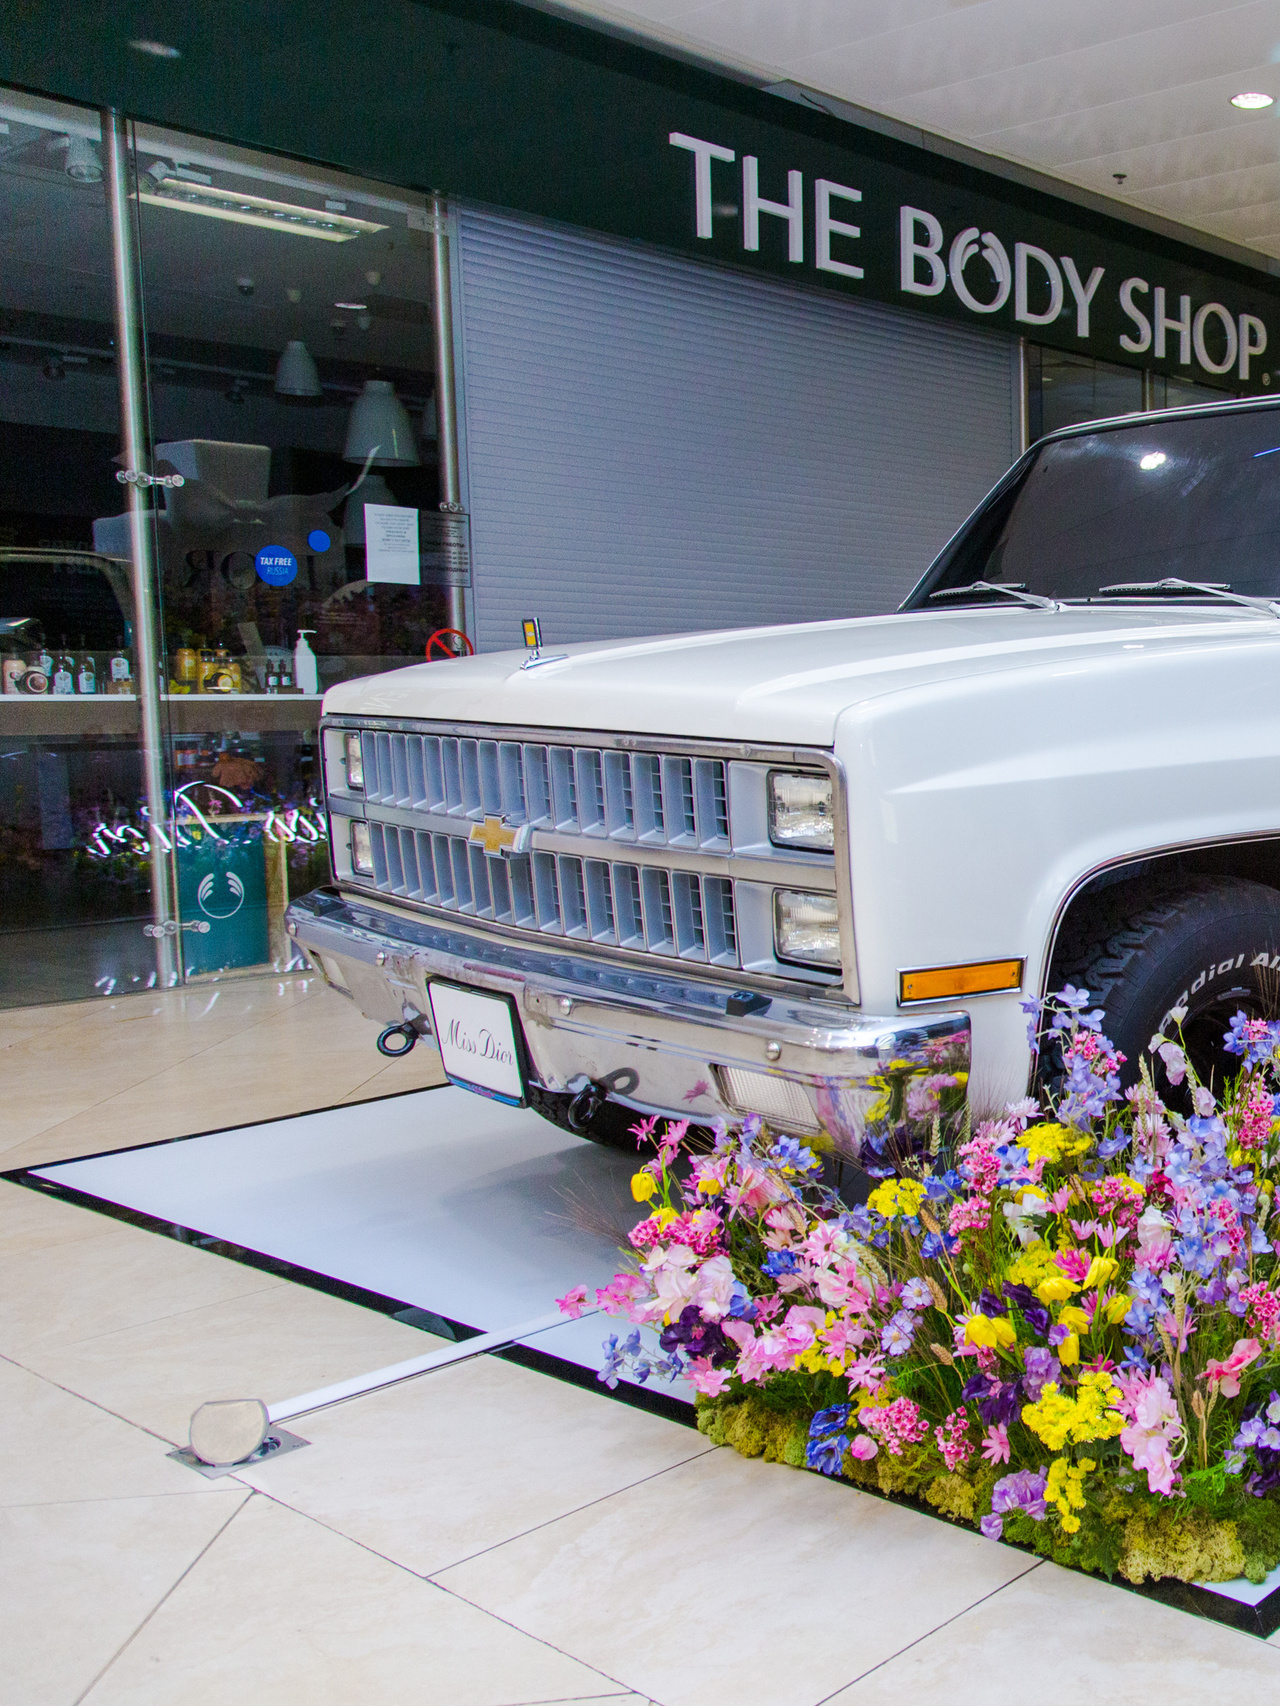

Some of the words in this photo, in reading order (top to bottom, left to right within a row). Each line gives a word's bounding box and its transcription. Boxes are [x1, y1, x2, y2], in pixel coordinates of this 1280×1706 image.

[669, 131, 864, 279] THE
[900, 205, 1105, 338] BODY
[1118, 276, 1268, 380] SHOP
[260, 556, 274, 566] TAX
[274, 557, 293, 566] FREE
[267, 566, 289, 576] RUSSIA
[441, 1018, 477, 1055] Miss
[479, 1028, 515, 1066] Dior
